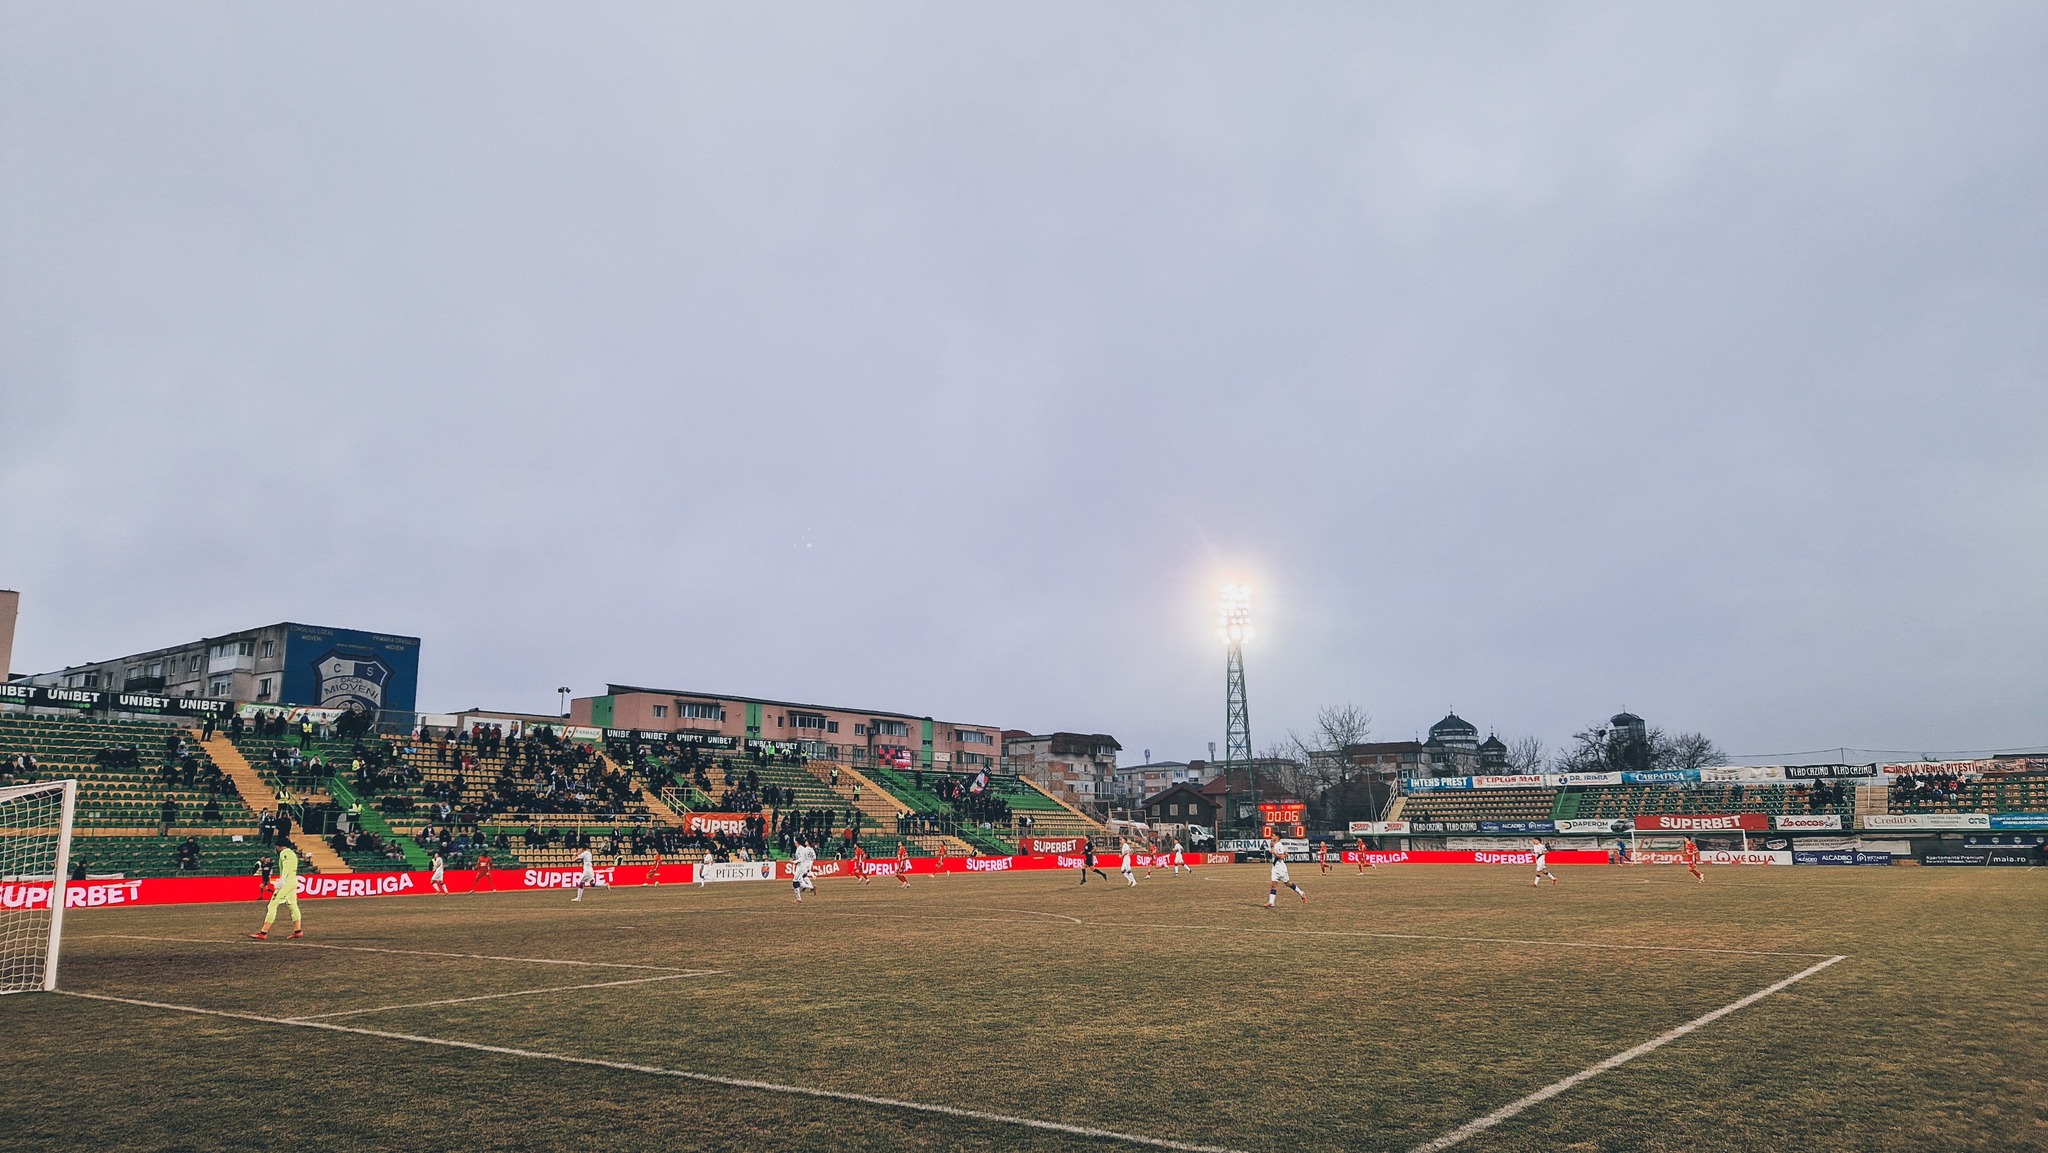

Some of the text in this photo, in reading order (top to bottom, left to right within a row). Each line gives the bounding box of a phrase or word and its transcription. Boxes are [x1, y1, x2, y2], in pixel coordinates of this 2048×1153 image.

[334, 663, 374, 676] C S
[324, 683, 378, 699] MIOVENI
[47, 689, 100, 703] UNIBET
[119, 694, 170, 708] UNIBET
[179, 699, 226, 712] UNIBET
[607, 729, 631, 738] UNIBE
[640, 732, 668, 741] UNIBET
[708, 736, 732, 744] UNIBET
[1790, 766, 1872, 776] VLAD CAZINO VLAD CAZINO
[1921, 764, 1945, 773] VENUS
[1947, 762, 1975, 773] PITESTI
[1441, 777, 1467, 786] PREST
[1636, 772, 1685, 781] CARPATINA
[1268, 811, 1298, 821] 00:06
[1660, 815, 1740, 829] SUPERBET
[691, 817, 748, 836] SUPERB
[1264, 826, 1303, 837] 0 0
[1033, 840, 1077, 853] SUPERBET
[1058, 855, 1099, 868] SUPERA
[1136, 854, 1170, 866] SUPBET
[1208, 854, 1228, 863] Betano
[1630, 851, 1683, 861] Betano
[785, 862, 840, 876] SRLIGA
[853, 860, 913, 875] UPERLA
[966, 856, 1013, 871] SUPERBET
[524, 866, 614, 888] SUPERET
[296, 873, 414, 897] SUPERLIGA
[0, 880, 142, 908] UPRBET
